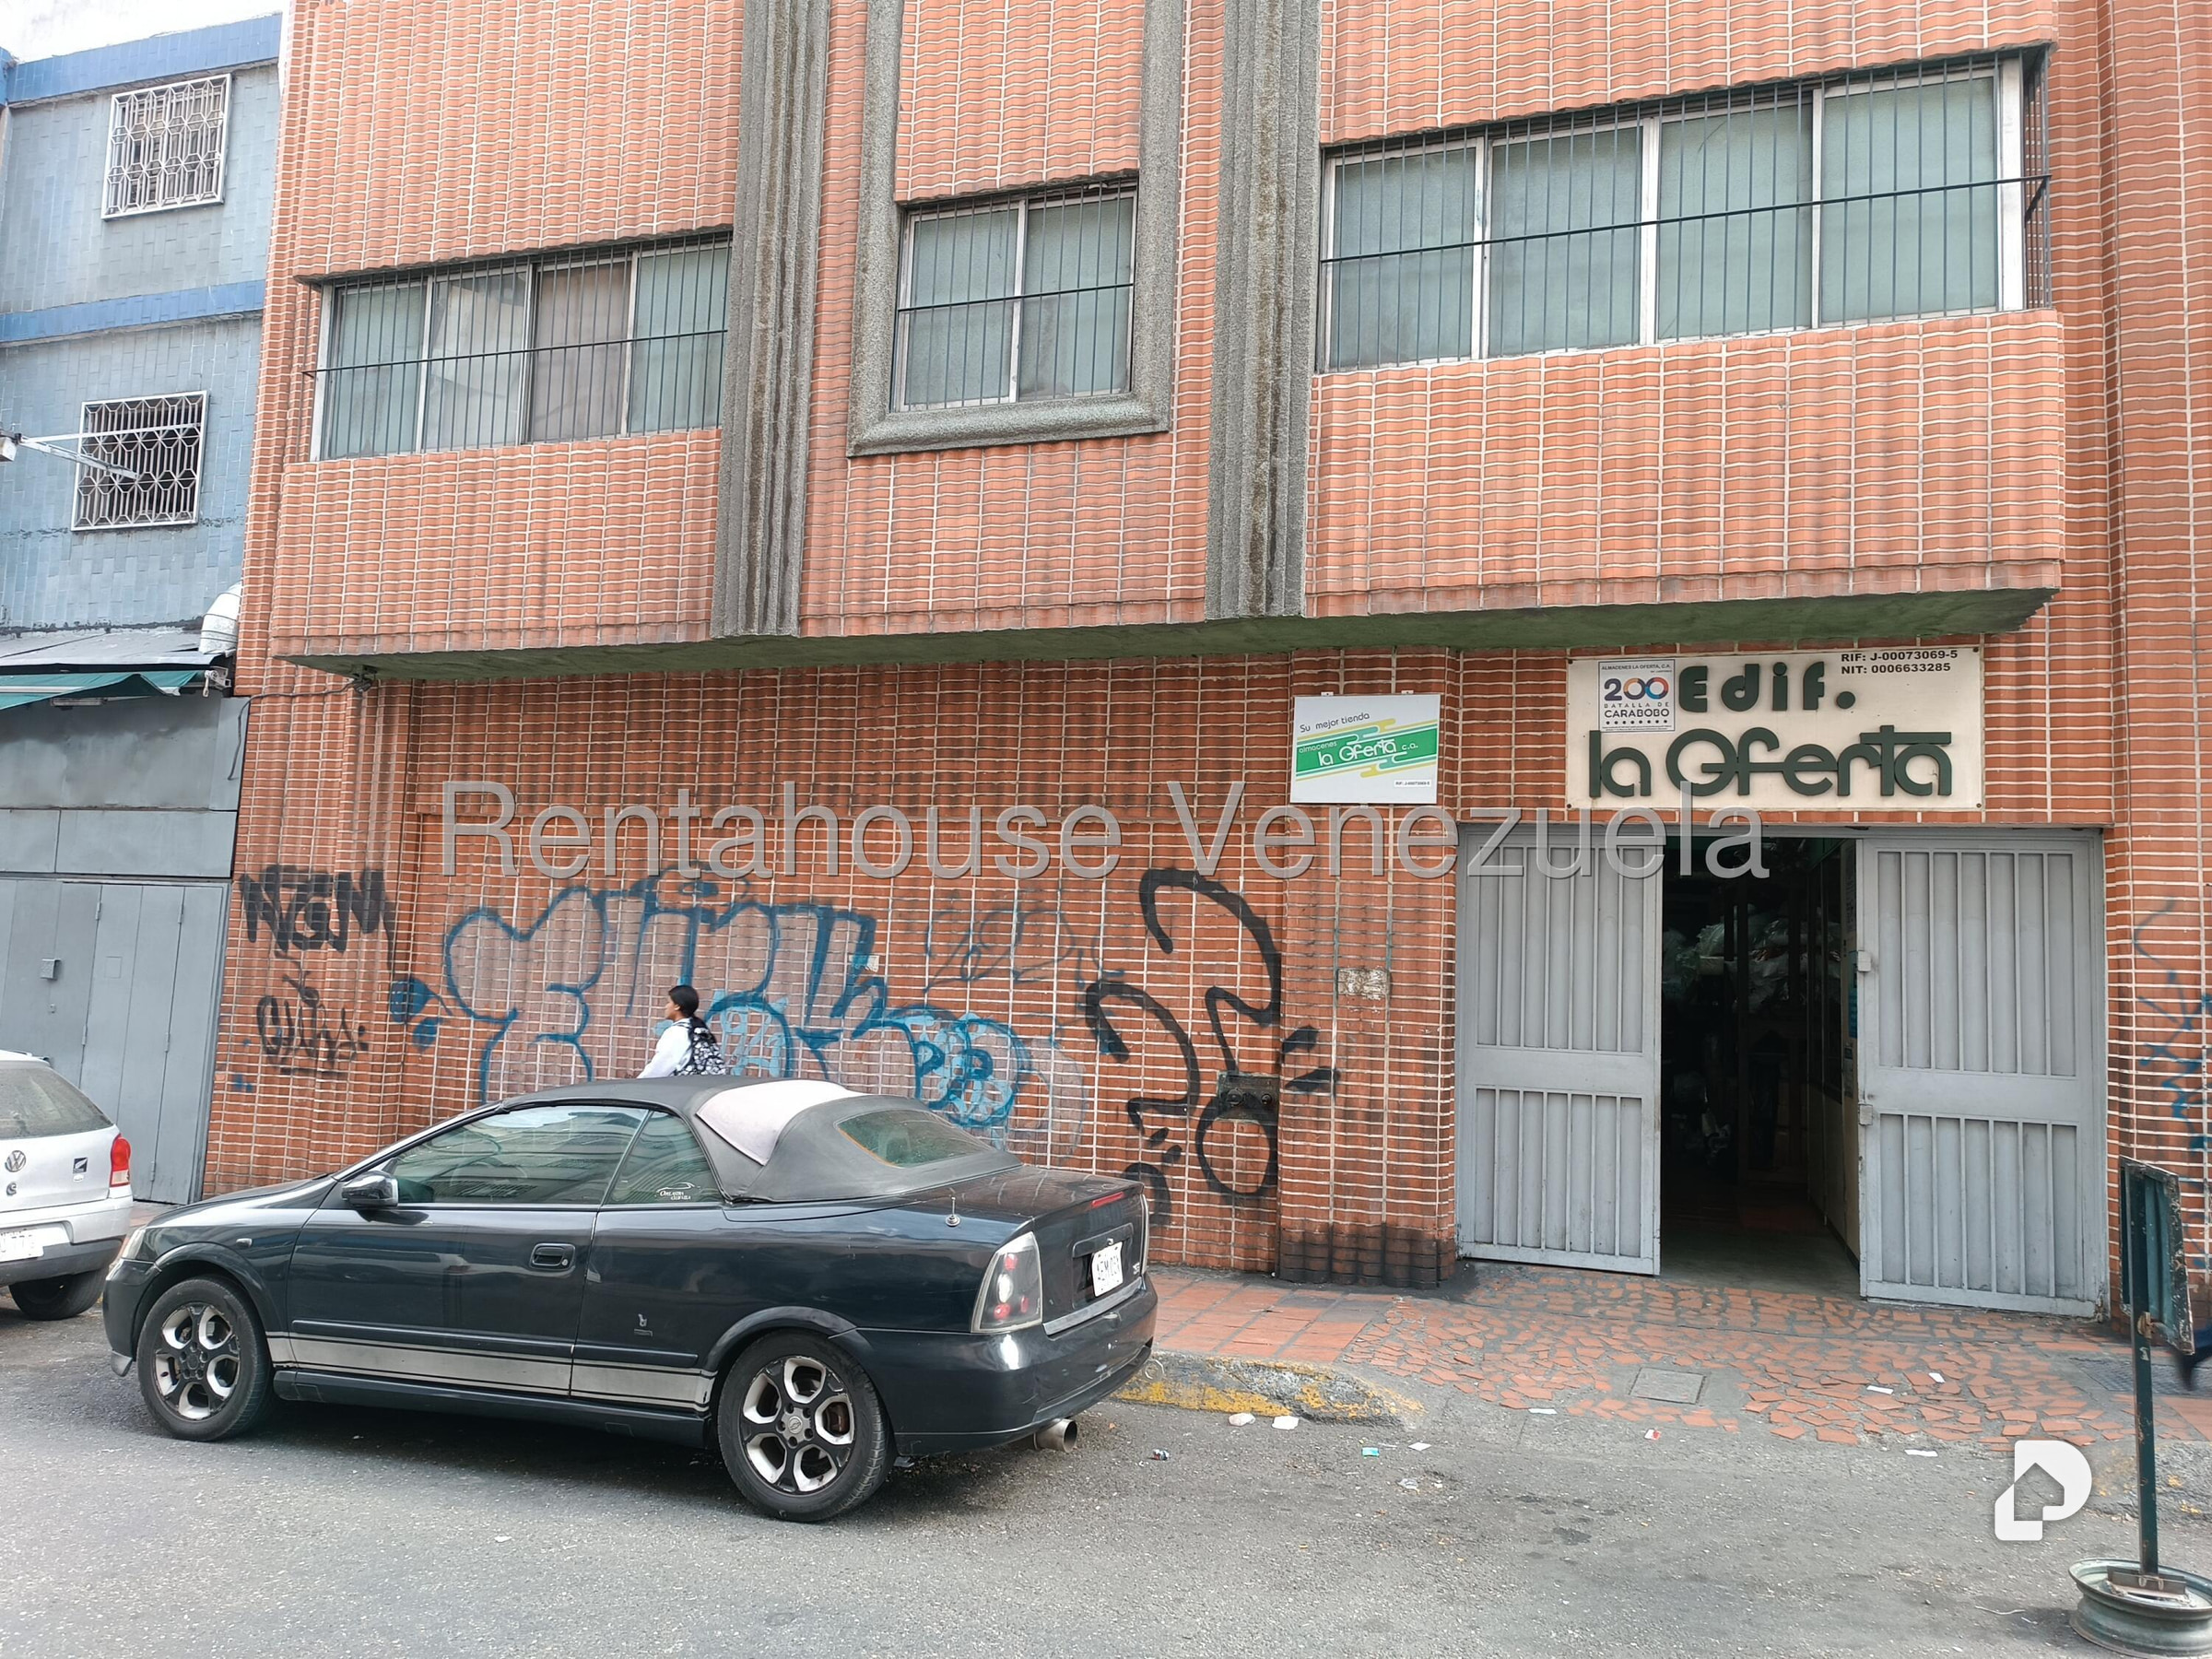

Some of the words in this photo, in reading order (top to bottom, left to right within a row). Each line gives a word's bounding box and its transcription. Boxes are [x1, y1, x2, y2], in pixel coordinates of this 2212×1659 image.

[1841, 653, 1866, 662] RIF:
[1870, 650, 1959, 662] J-00073069-5
[1841, 665, 1867, 675] NIT:
[1871, 663, 1951, 674] 0006633285
[1604, 677, 1669, 700] 200
[1678, 661, 1856, 712] Edif.
[1300, 724, 1311, 733] Su
[1315, 718, 1339, 729] mejor
[1341, 712, 1370, 724] tienda
[1604, 709, 1670, 718] CARABOBO
[1299, 741, 1337, 753] almacenes
[1318, 751, 1334, 766] la
[1339, 738, 1397, 761] Oferta
[1588, 730, 1652, 798] la
[1665, 724, 1952, 798] Oferta
